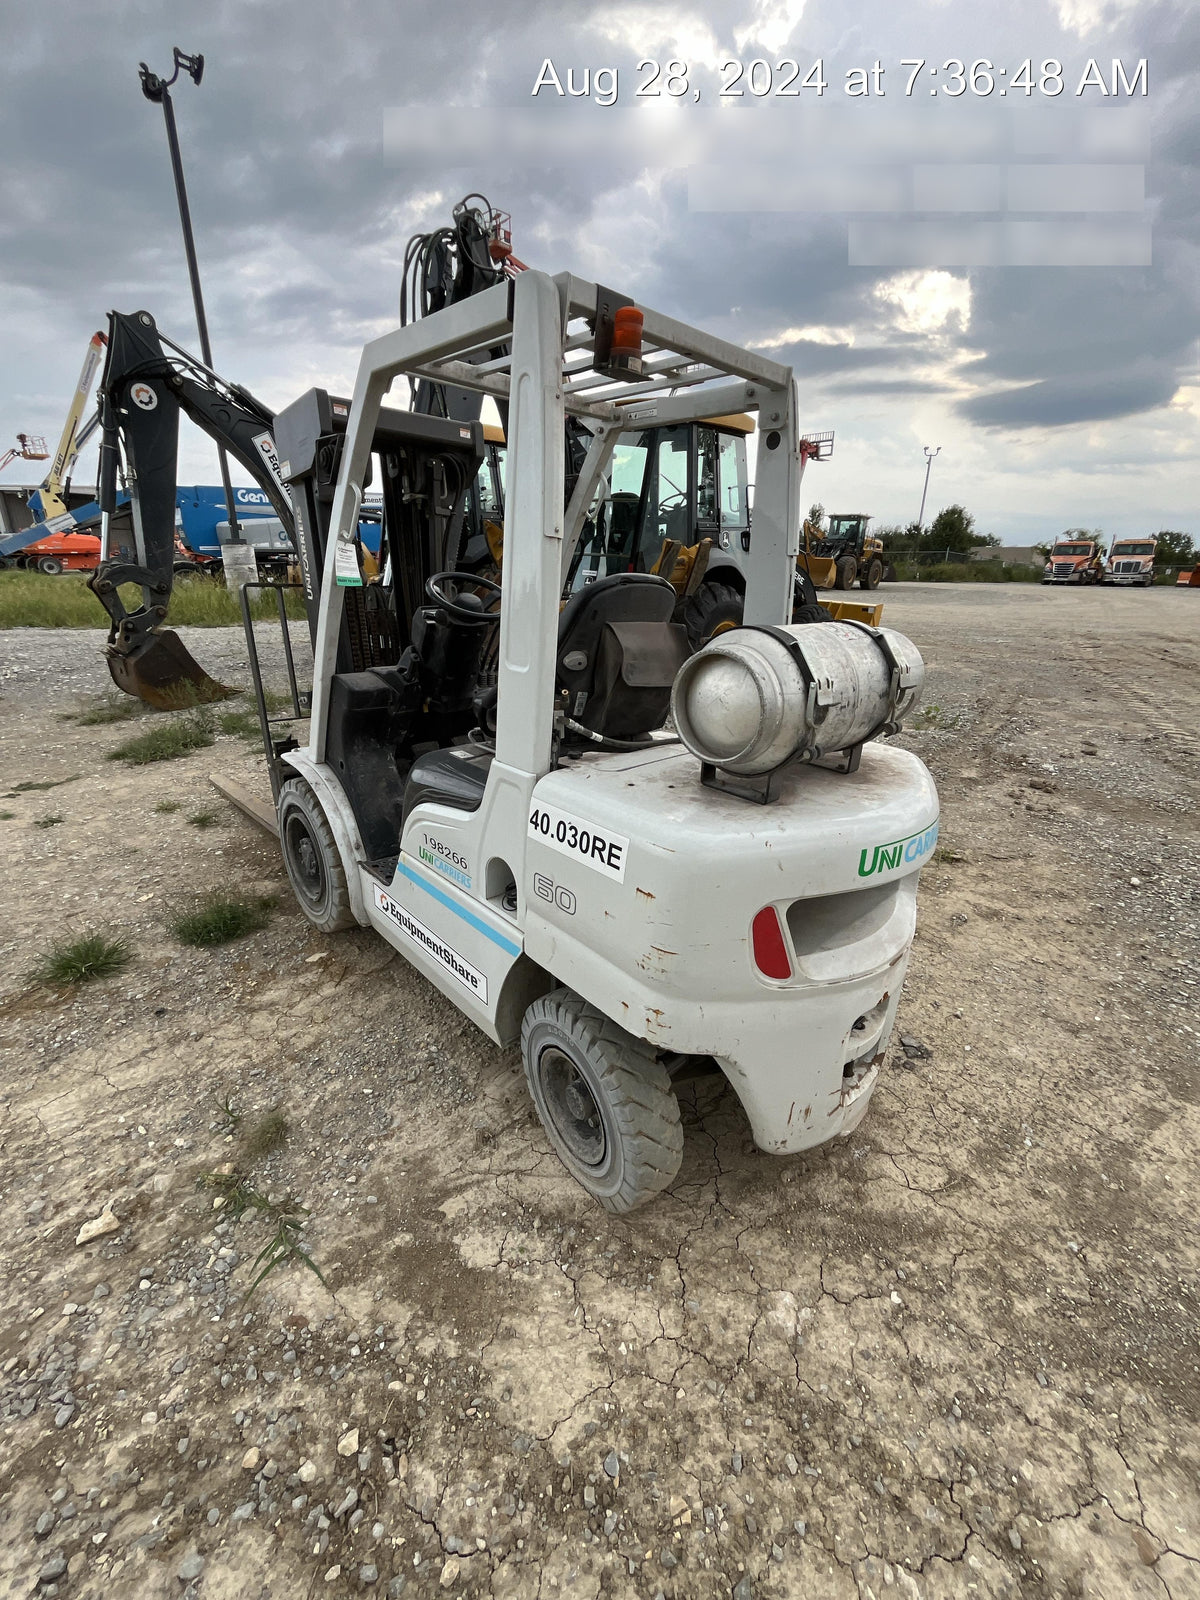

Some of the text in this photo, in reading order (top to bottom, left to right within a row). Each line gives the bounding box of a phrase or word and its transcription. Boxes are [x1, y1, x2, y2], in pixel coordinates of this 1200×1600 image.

[237, 489, 270, 503] Geni
[423, 833, 468, 869] 198266
[530, 809, 623, 870] 40.030RE
[418, 845, 472, 889] UNICARRIERS
[533, 872, 577, 915] 60
[390, 900, 478, 988] EquipmentShare
